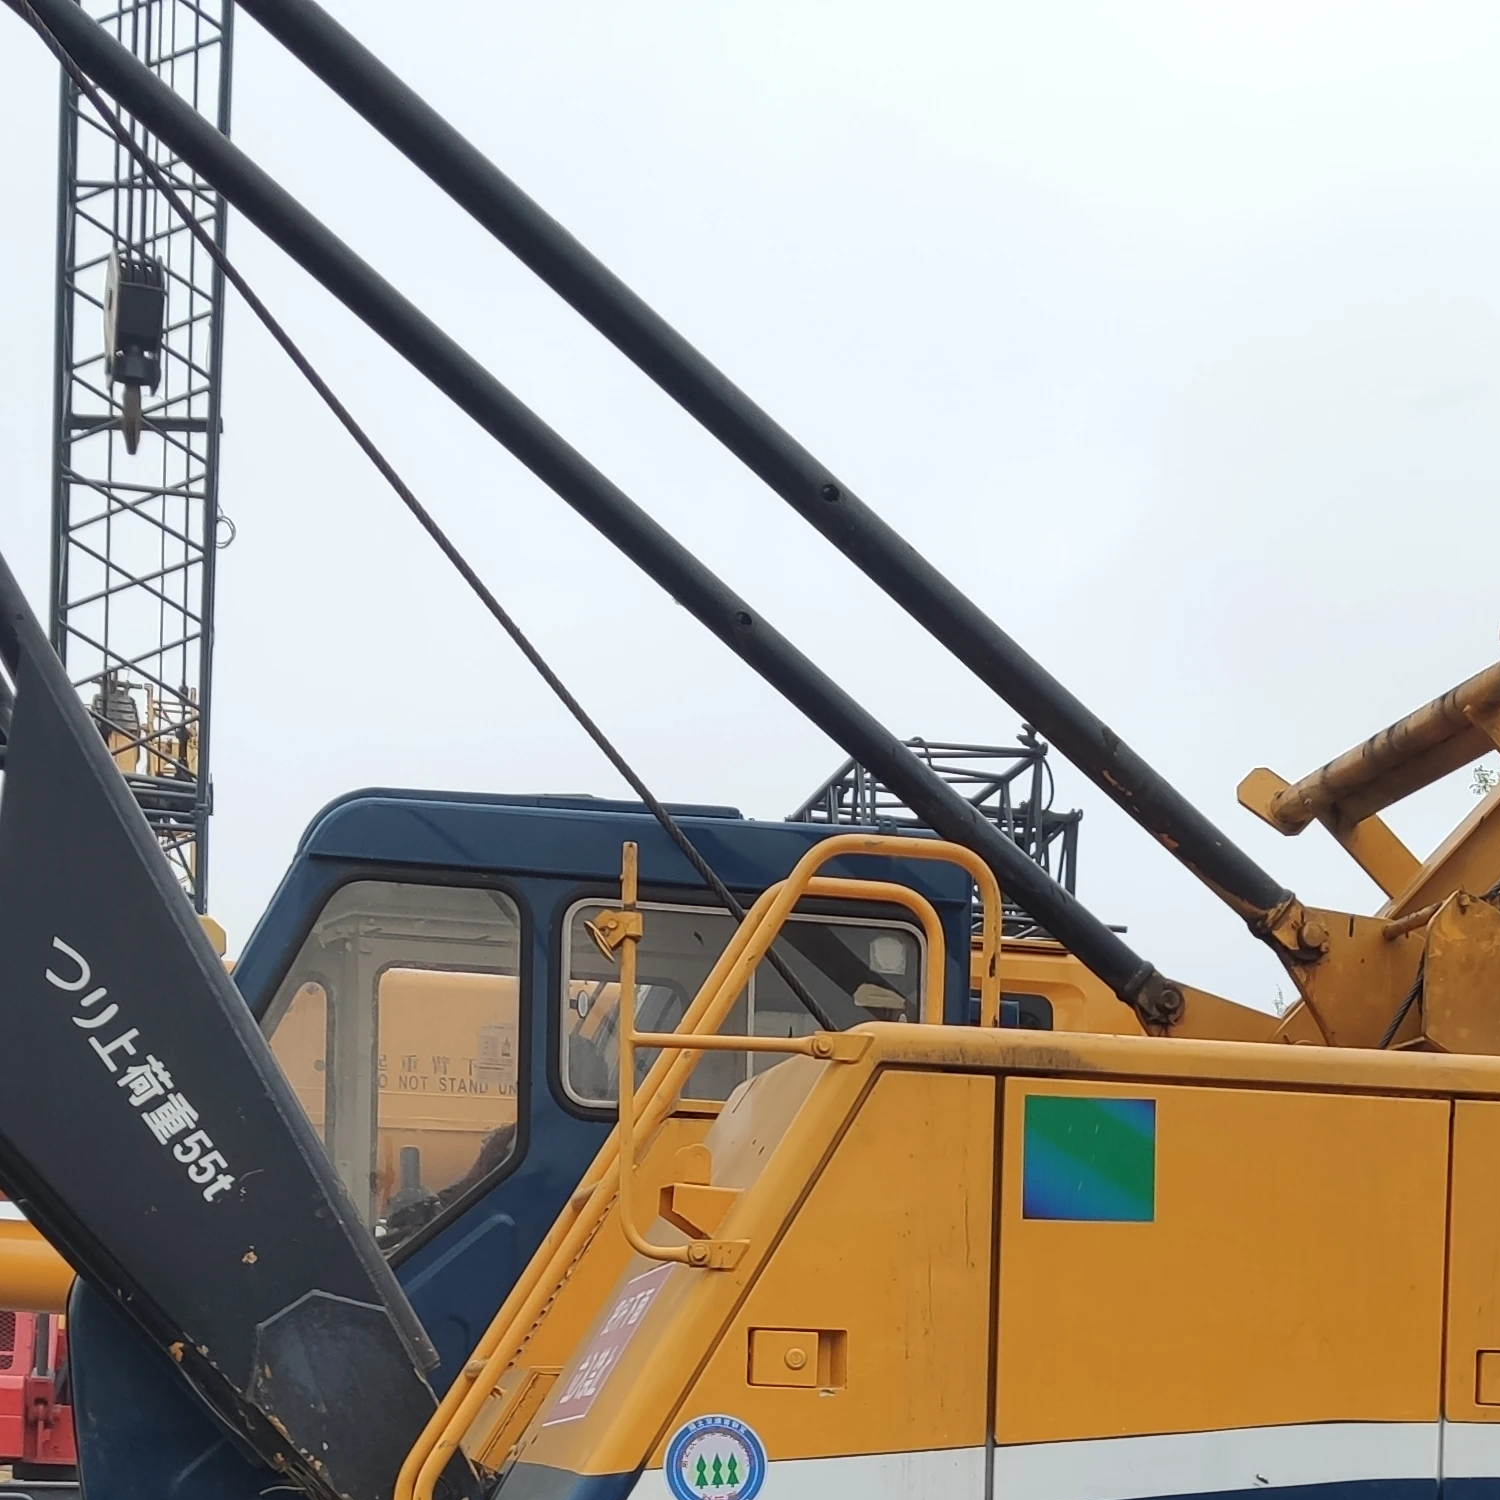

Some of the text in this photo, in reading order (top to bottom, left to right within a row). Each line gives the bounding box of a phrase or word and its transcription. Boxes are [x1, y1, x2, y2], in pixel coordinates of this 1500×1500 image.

[46, 936, 235, 1202] つり上荷重55t
[399, 1075, 428, 1091] NOT
[439, 1077, 489, 1094] STAND
